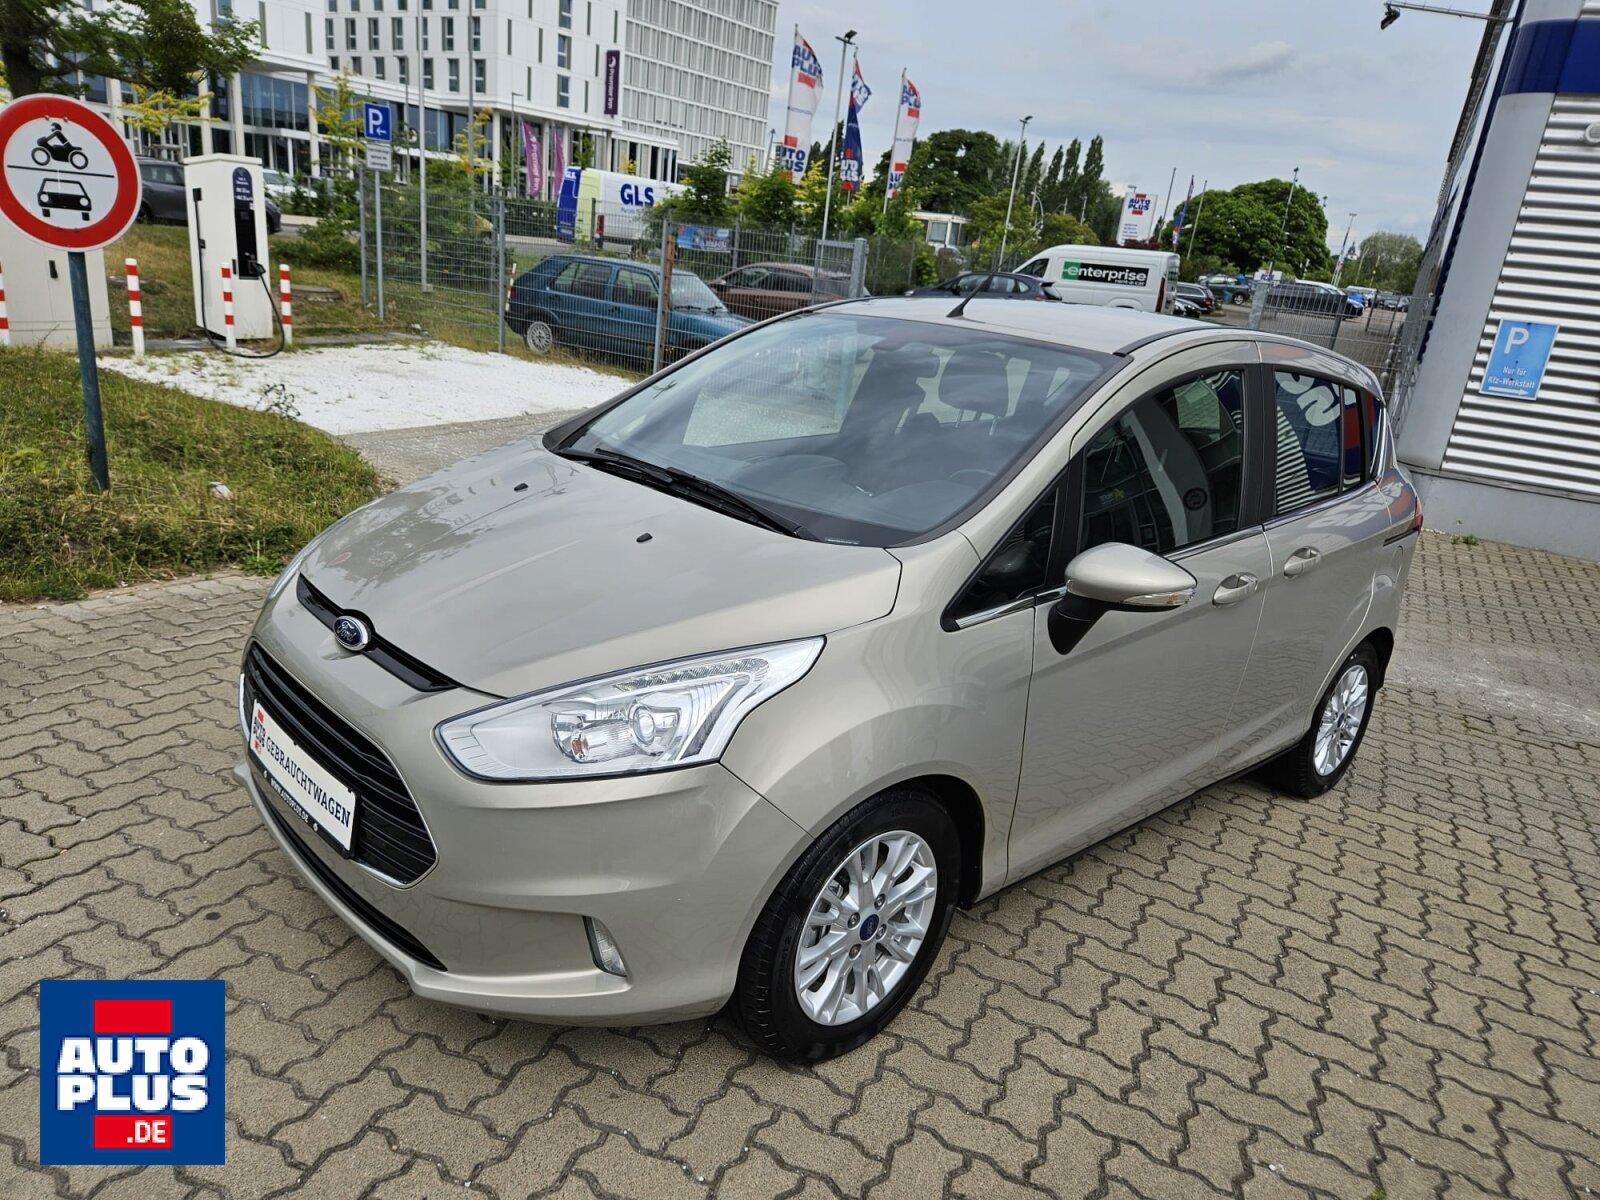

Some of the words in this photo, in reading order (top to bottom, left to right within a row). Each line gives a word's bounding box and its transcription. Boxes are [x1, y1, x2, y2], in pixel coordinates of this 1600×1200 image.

[368, 107, 383, 135] P
[620, 183, 654, 208] GLS
[1129, 198, 1151, 206] AUTO
[1128, 203, 1150, 211] PLUS
[1066, 265, 1147, 282] enterprise
[1504, 326, 1530, 354] P
[1502, 366, 1515, 375] Nur
[1516, 367, 1528, 376] für
[1487, 375, 1536, 389] Kfz-Werkstatt
[266, 736, 351, 828] GEBRAUCHTWAGEN
